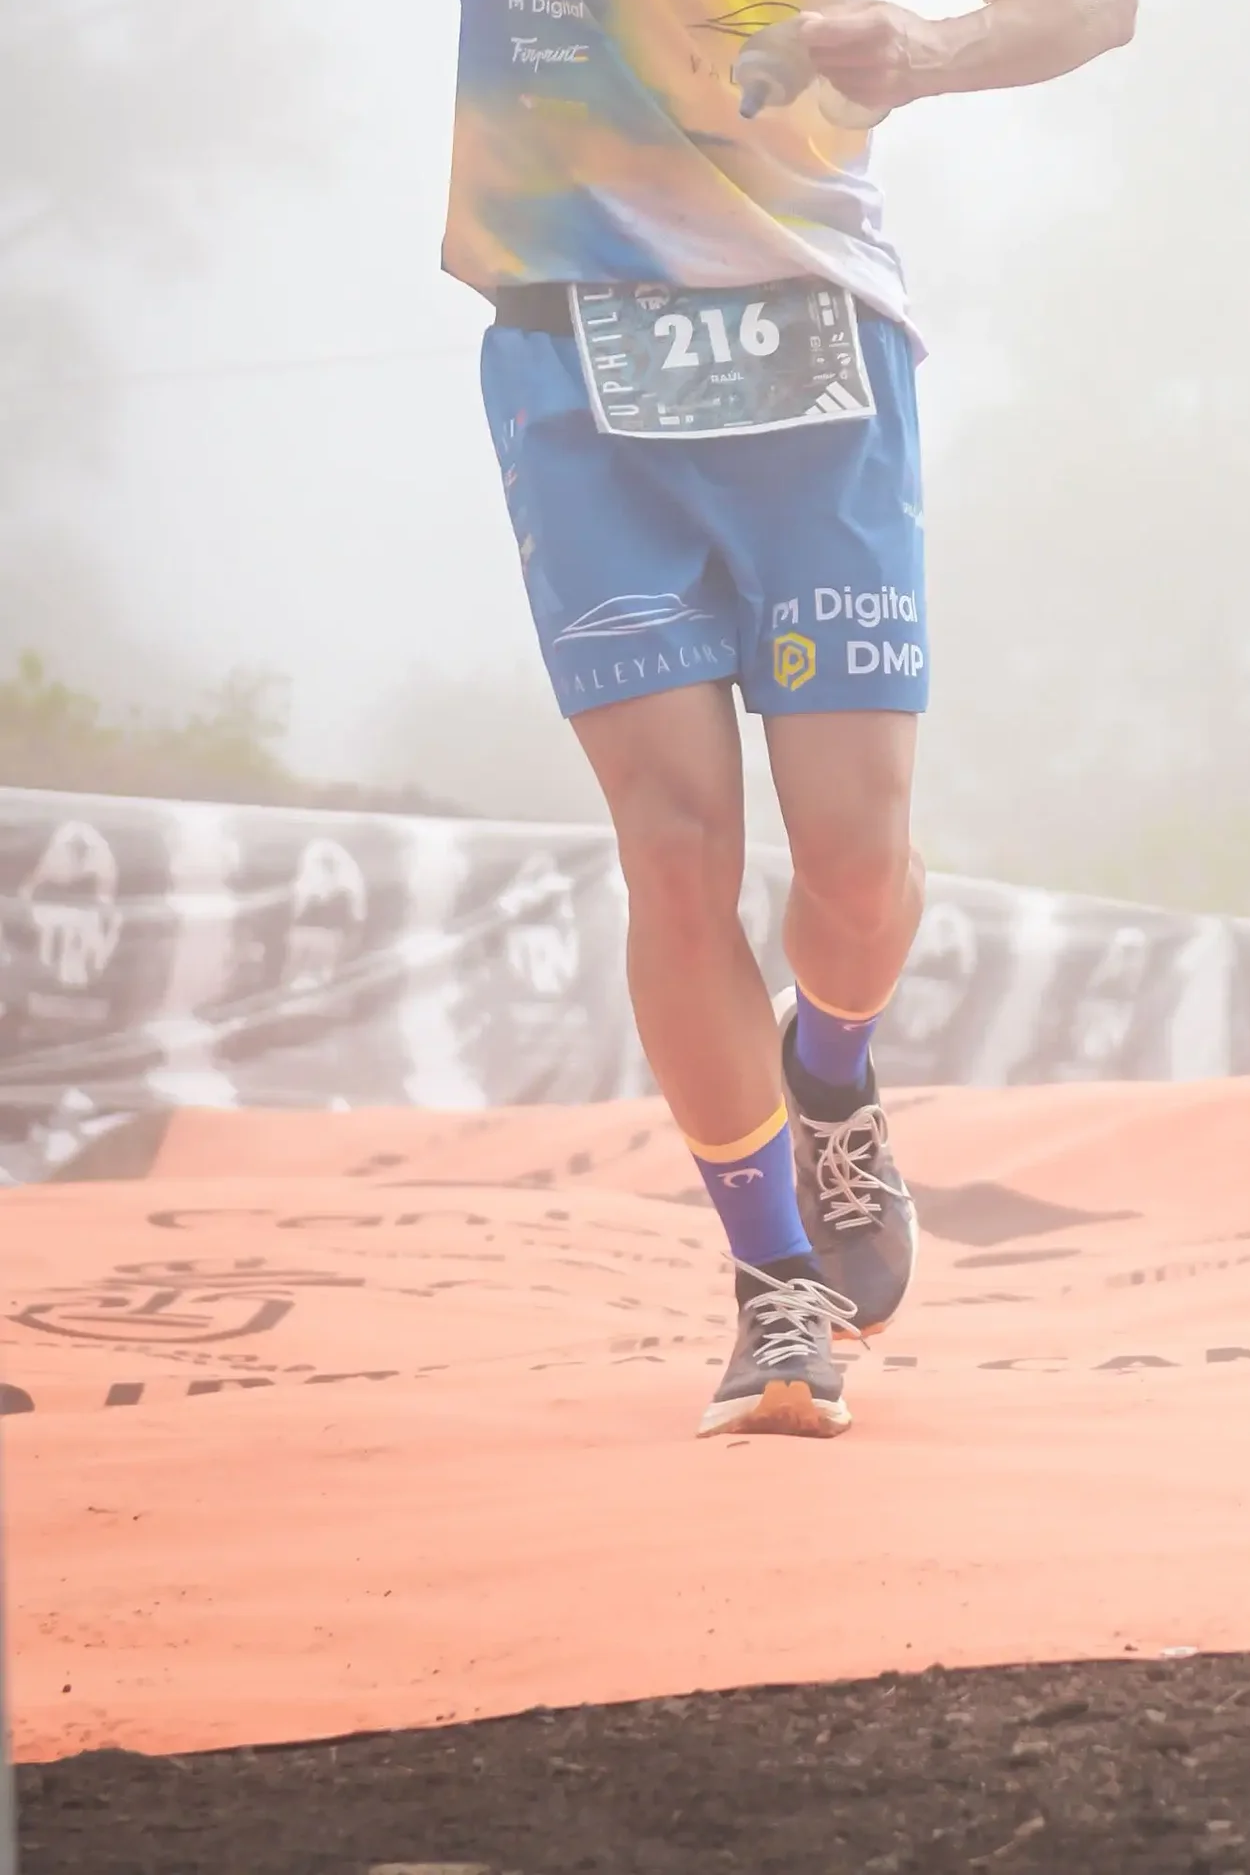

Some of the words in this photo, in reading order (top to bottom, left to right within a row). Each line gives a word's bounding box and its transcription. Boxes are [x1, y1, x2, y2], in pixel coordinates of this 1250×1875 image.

[582, 284, 640, 417] UPHILL
[654, 302, 780, 370] 216
[710, 370, 744, 384] RAÚL
[815, 585, 918, 628] Digital
[847, 640, 924, 677] DMP
